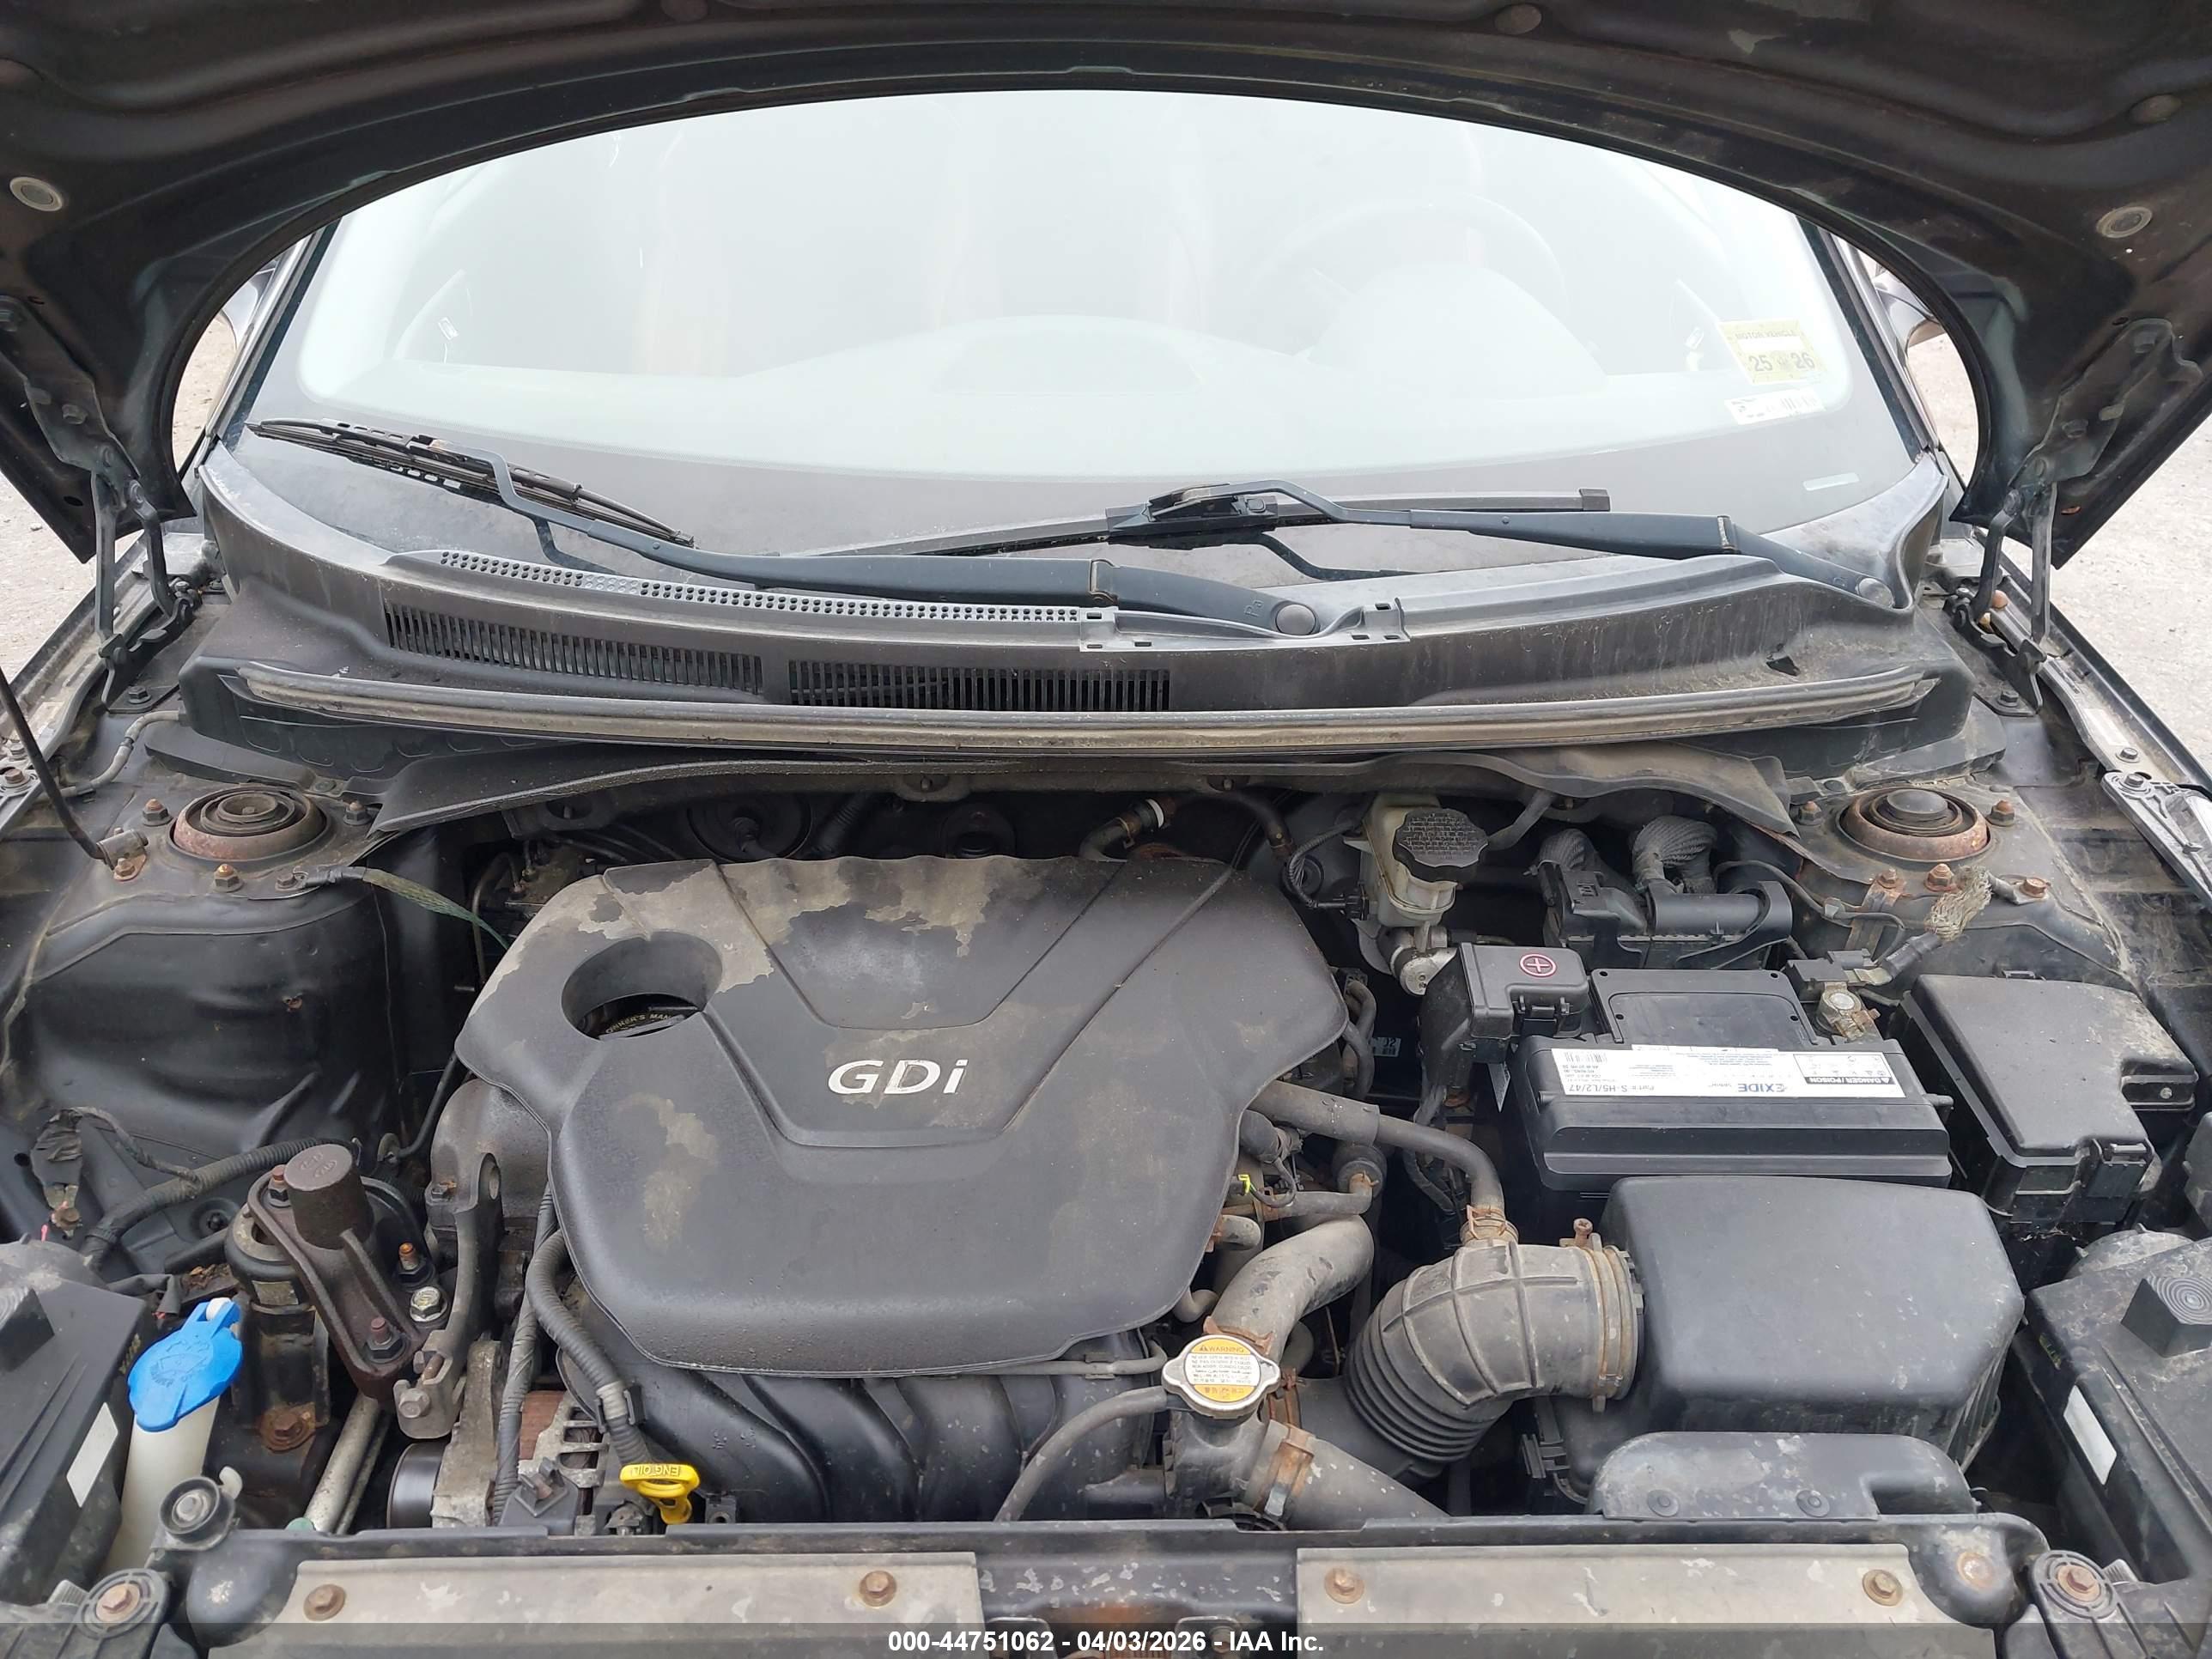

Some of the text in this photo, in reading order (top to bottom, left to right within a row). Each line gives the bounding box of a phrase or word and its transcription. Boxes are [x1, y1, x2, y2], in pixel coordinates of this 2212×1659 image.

[1735, 330, 1763, 340] MOTOR
[1748, 354, 1773, 372] 25
[1790, 351, 1815, 369] 26
[605, 1014, 646, 1034] OWNER'S
[827, 1059, 969, 1095] GDi
[1737, 1082, 1787, 1093] EXIDE
[1209, 1345, 1244, 1353] WARNING
[633, 1465, 681, 1477] ENG OIL
